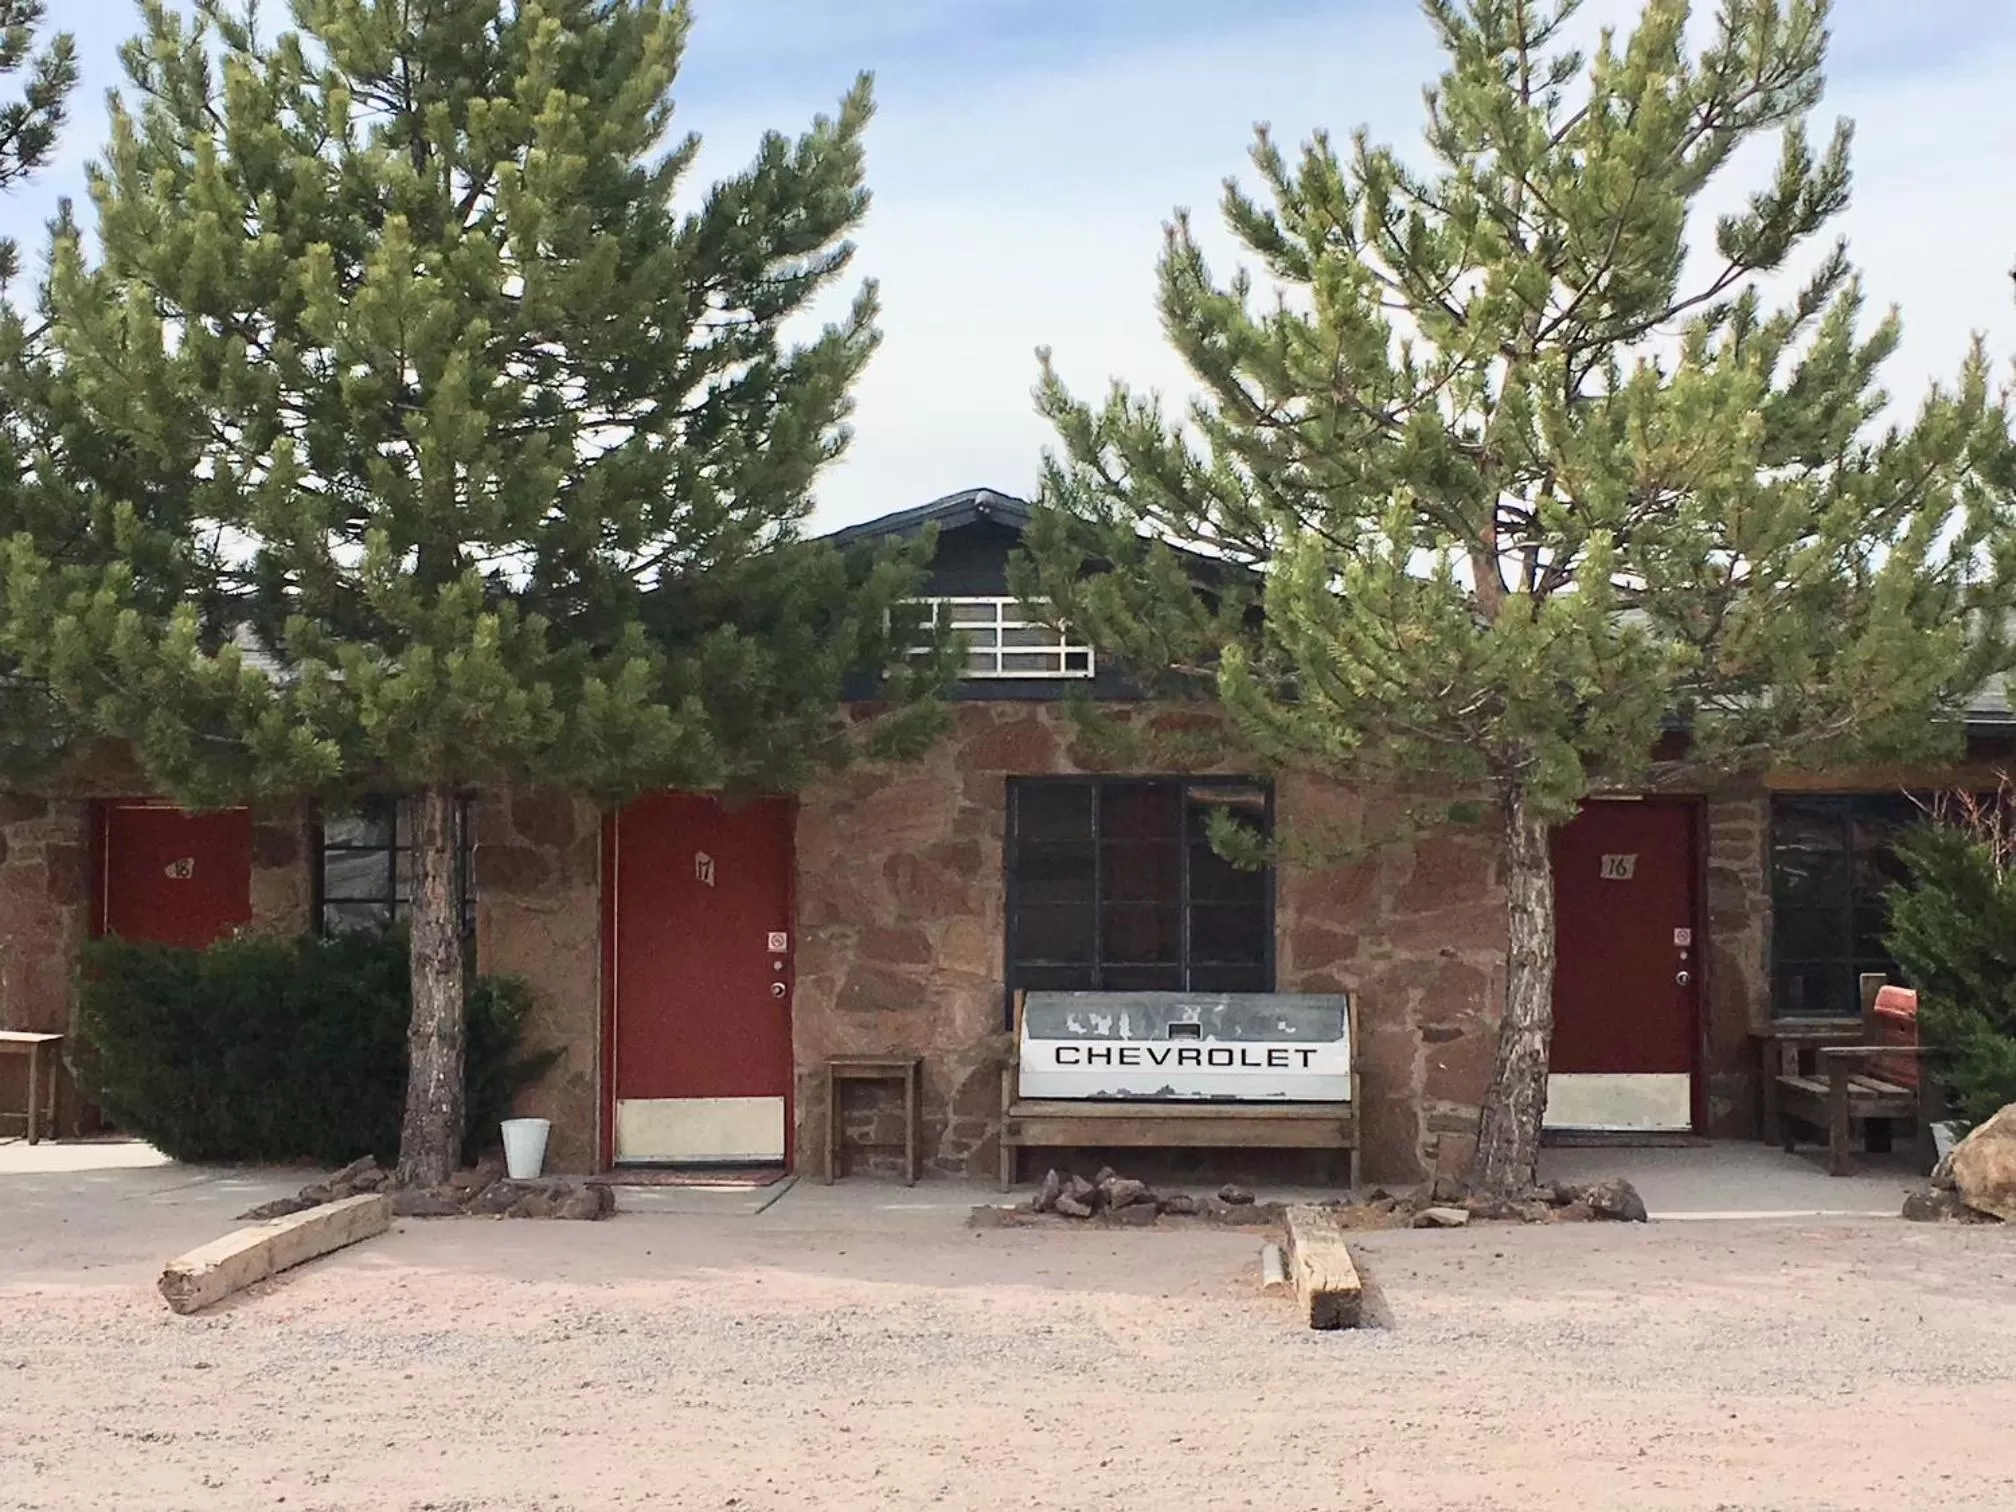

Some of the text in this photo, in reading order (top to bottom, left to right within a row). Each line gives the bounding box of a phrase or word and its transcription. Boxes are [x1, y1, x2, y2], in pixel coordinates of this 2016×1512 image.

[698, 859, 711, 880] 17
[1609, 858, 1627, 877] 16
[1054, 1046, 1318, 1068] CHEVROLET
